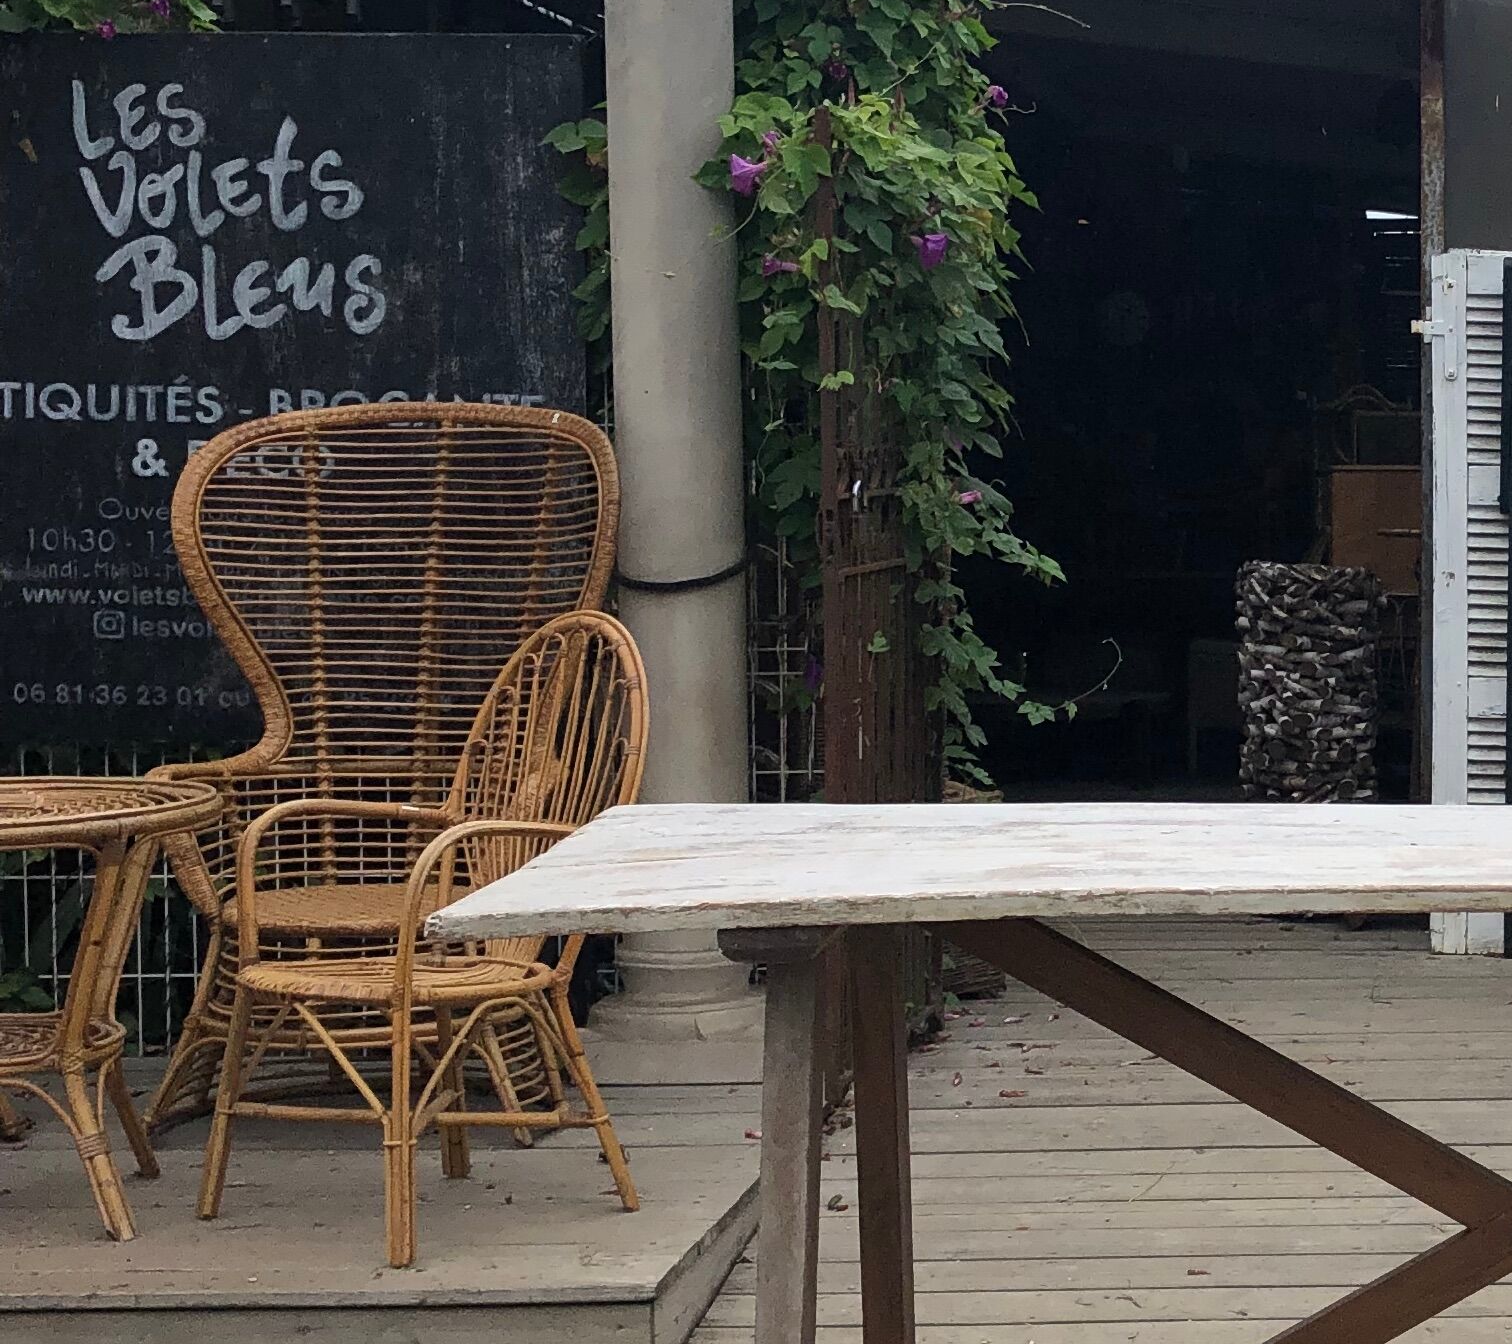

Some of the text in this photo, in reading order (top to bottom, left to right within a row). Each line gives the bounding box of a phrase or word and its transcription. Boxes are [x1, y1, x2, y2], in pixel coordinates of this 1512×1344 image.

[72, 79, 207, 159] LES
[131, 438, 169, 477] &
[28, 527, 117, 553] 10h30
[13, 682, 46, 704] 06
[56, 683, 83, 705] 81
[136, 685, 168, 705] 23
